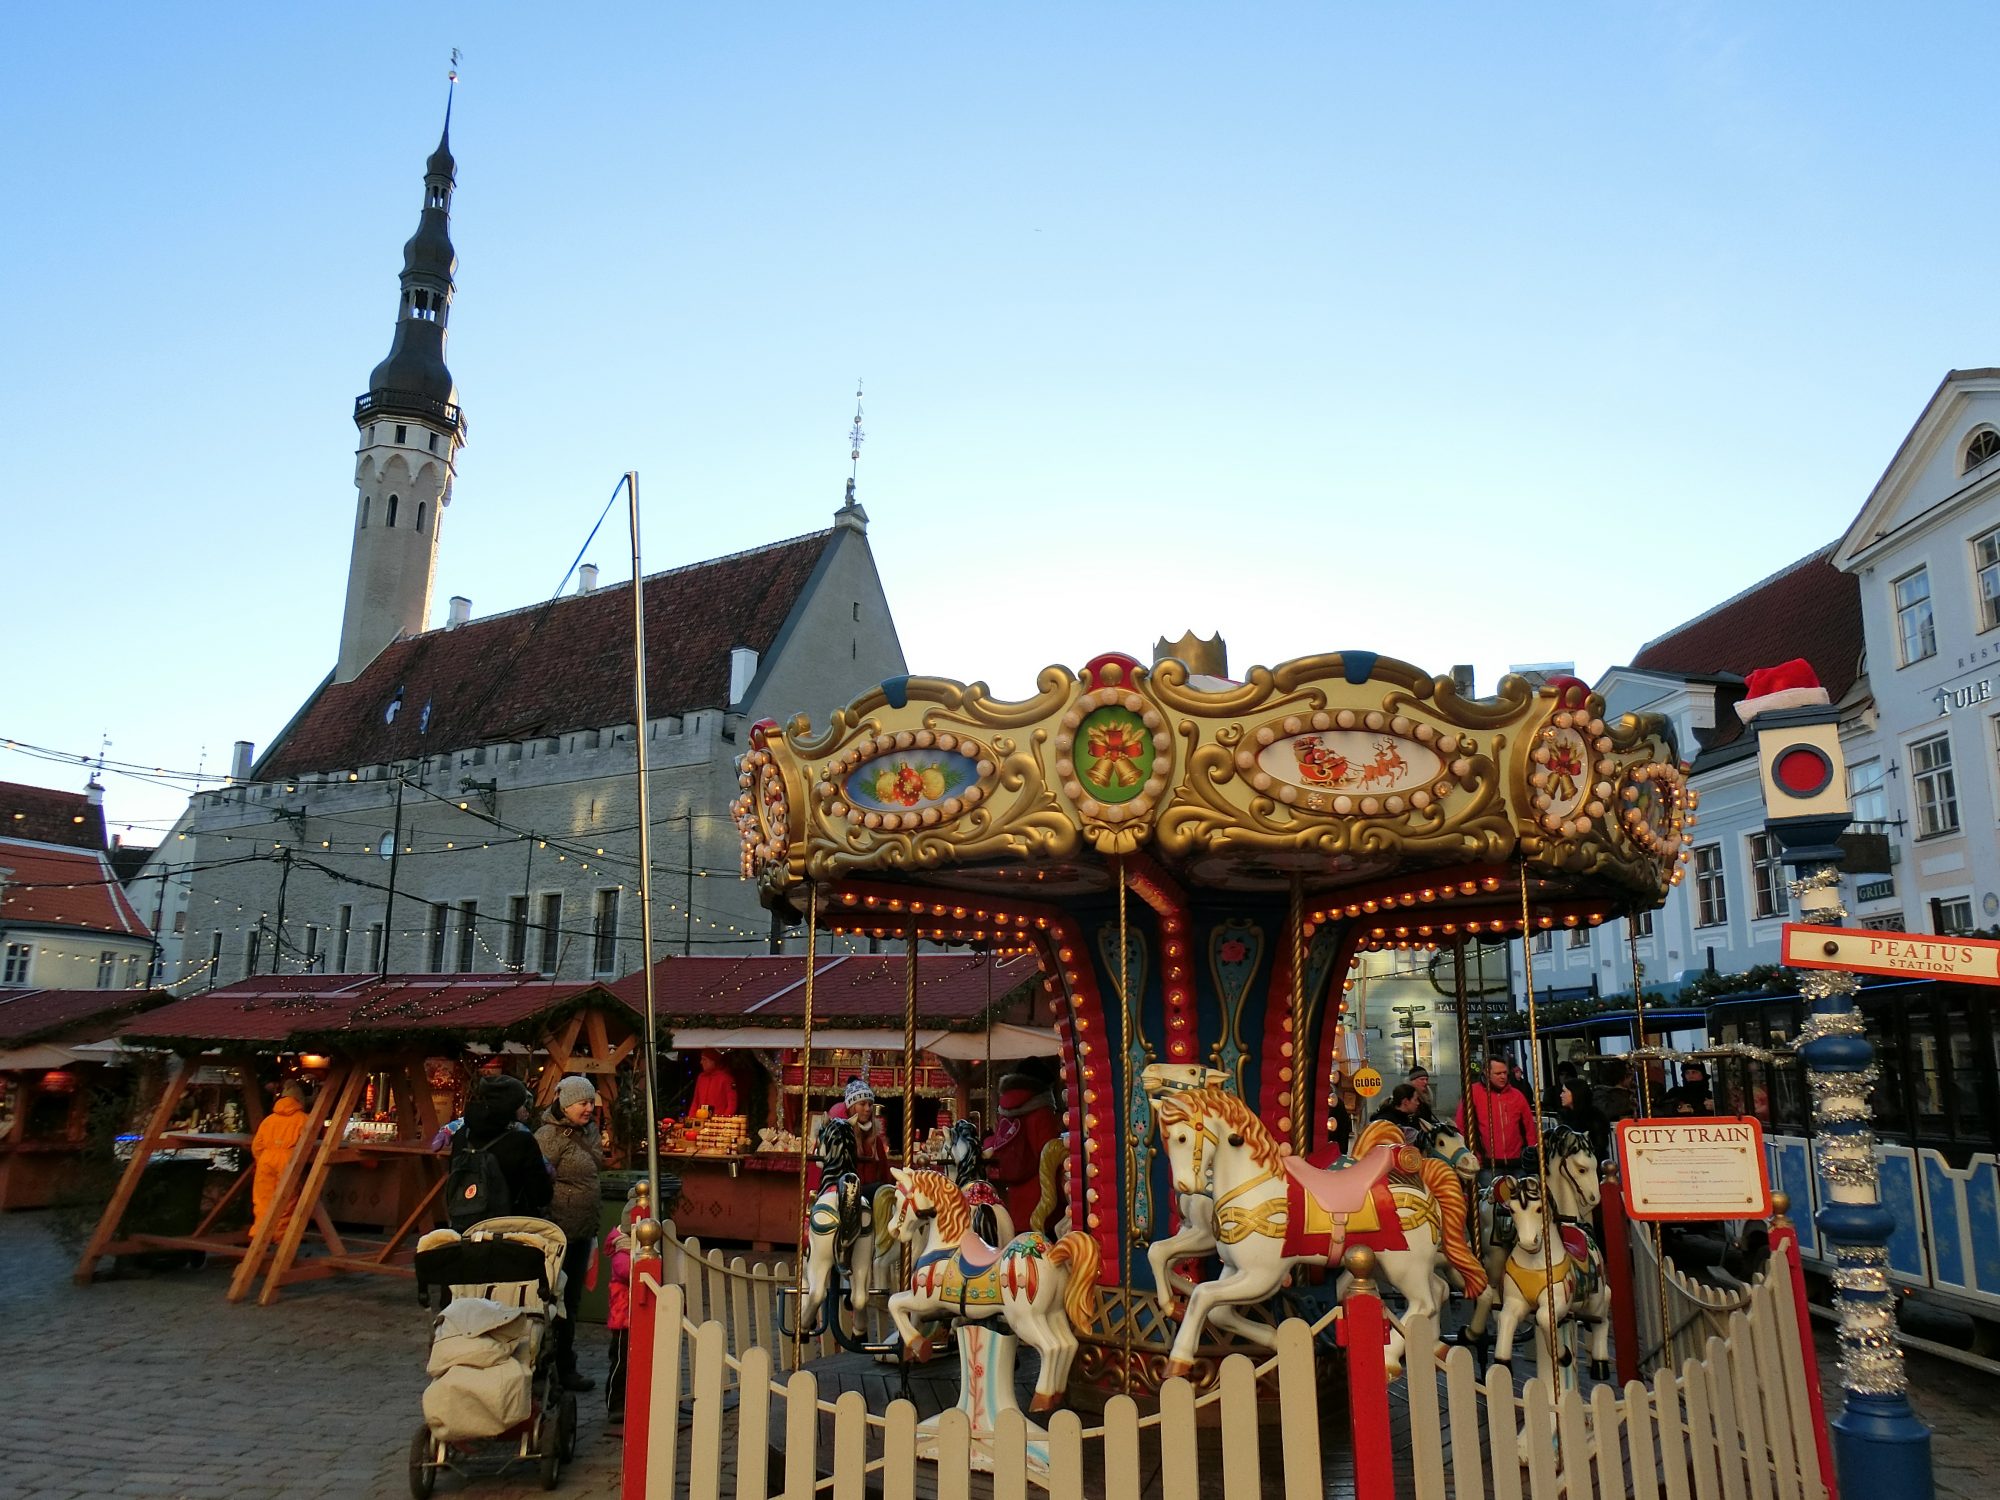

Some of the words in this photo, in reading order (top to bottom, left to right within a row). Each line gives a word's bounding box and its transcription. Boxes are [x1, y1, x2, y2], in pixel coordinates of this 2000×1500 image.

[1859, 882, 1892, 899] GRILL
[1869, 939, 1974, 964] PEATUS
[1889, 958, 1955, 973] STATION
[1354, 1076, 1381, 1088] GLÖGG
[1627, 1129, 1677, 1144] CITY
[1682, 1127, 1750, 1143] TRAIN
